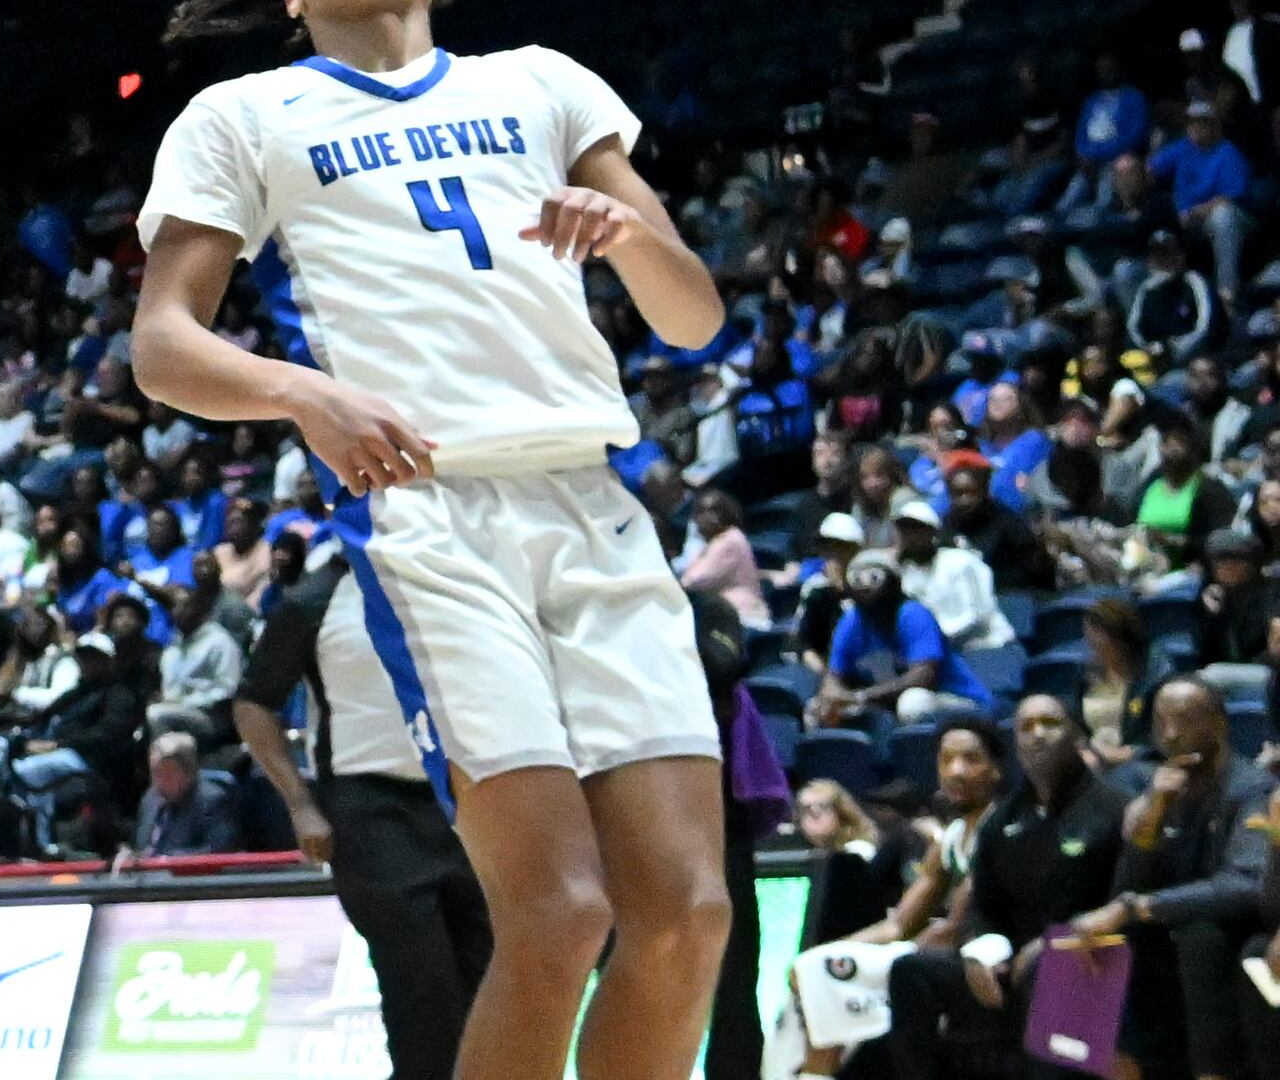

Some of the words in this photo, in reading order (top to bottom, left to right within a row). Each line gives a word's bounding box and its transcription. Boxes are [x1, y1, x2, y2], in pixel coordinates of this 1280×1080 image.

[308, 132, 400, 186] BLUE
[405, 117, 526, 162] DEVILS
[405, 176, 494, 270] 4
